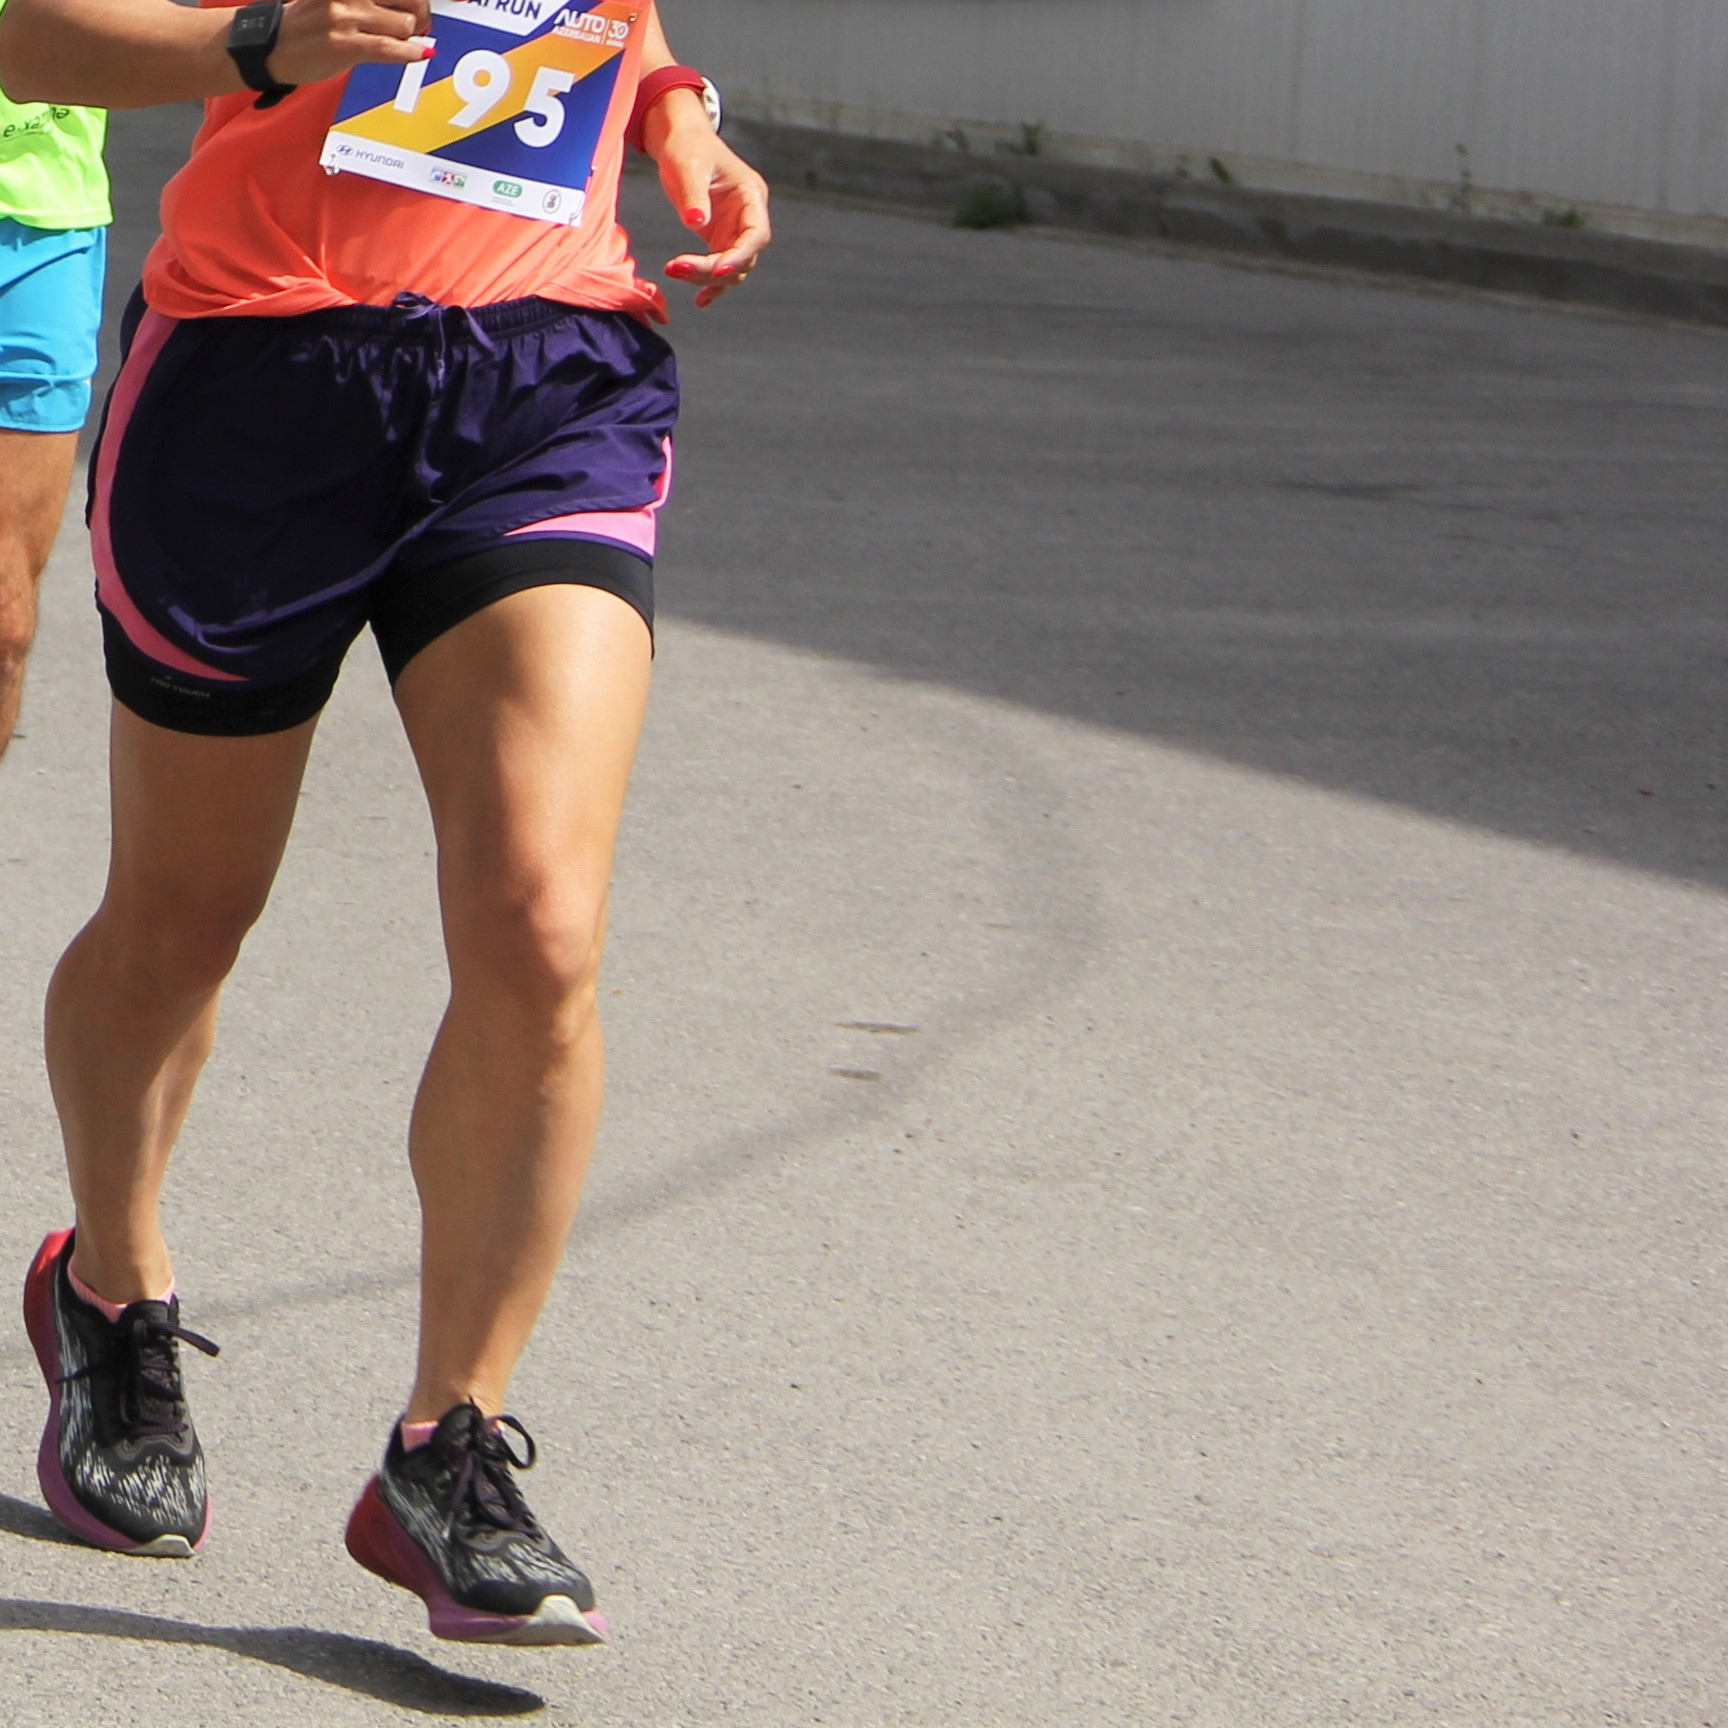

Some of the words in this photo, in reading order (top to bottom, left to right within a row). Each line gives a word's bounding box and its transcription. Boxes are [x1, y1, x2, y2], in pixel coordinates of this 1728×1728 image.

[553, 8, 606, 33] AUTO
[608, 19, 630, 40] 30
[393, 34, 576, 148] 195
[355, 150, 405, 170] HYUNDAI
[496, 182, 519, 197] AZE
